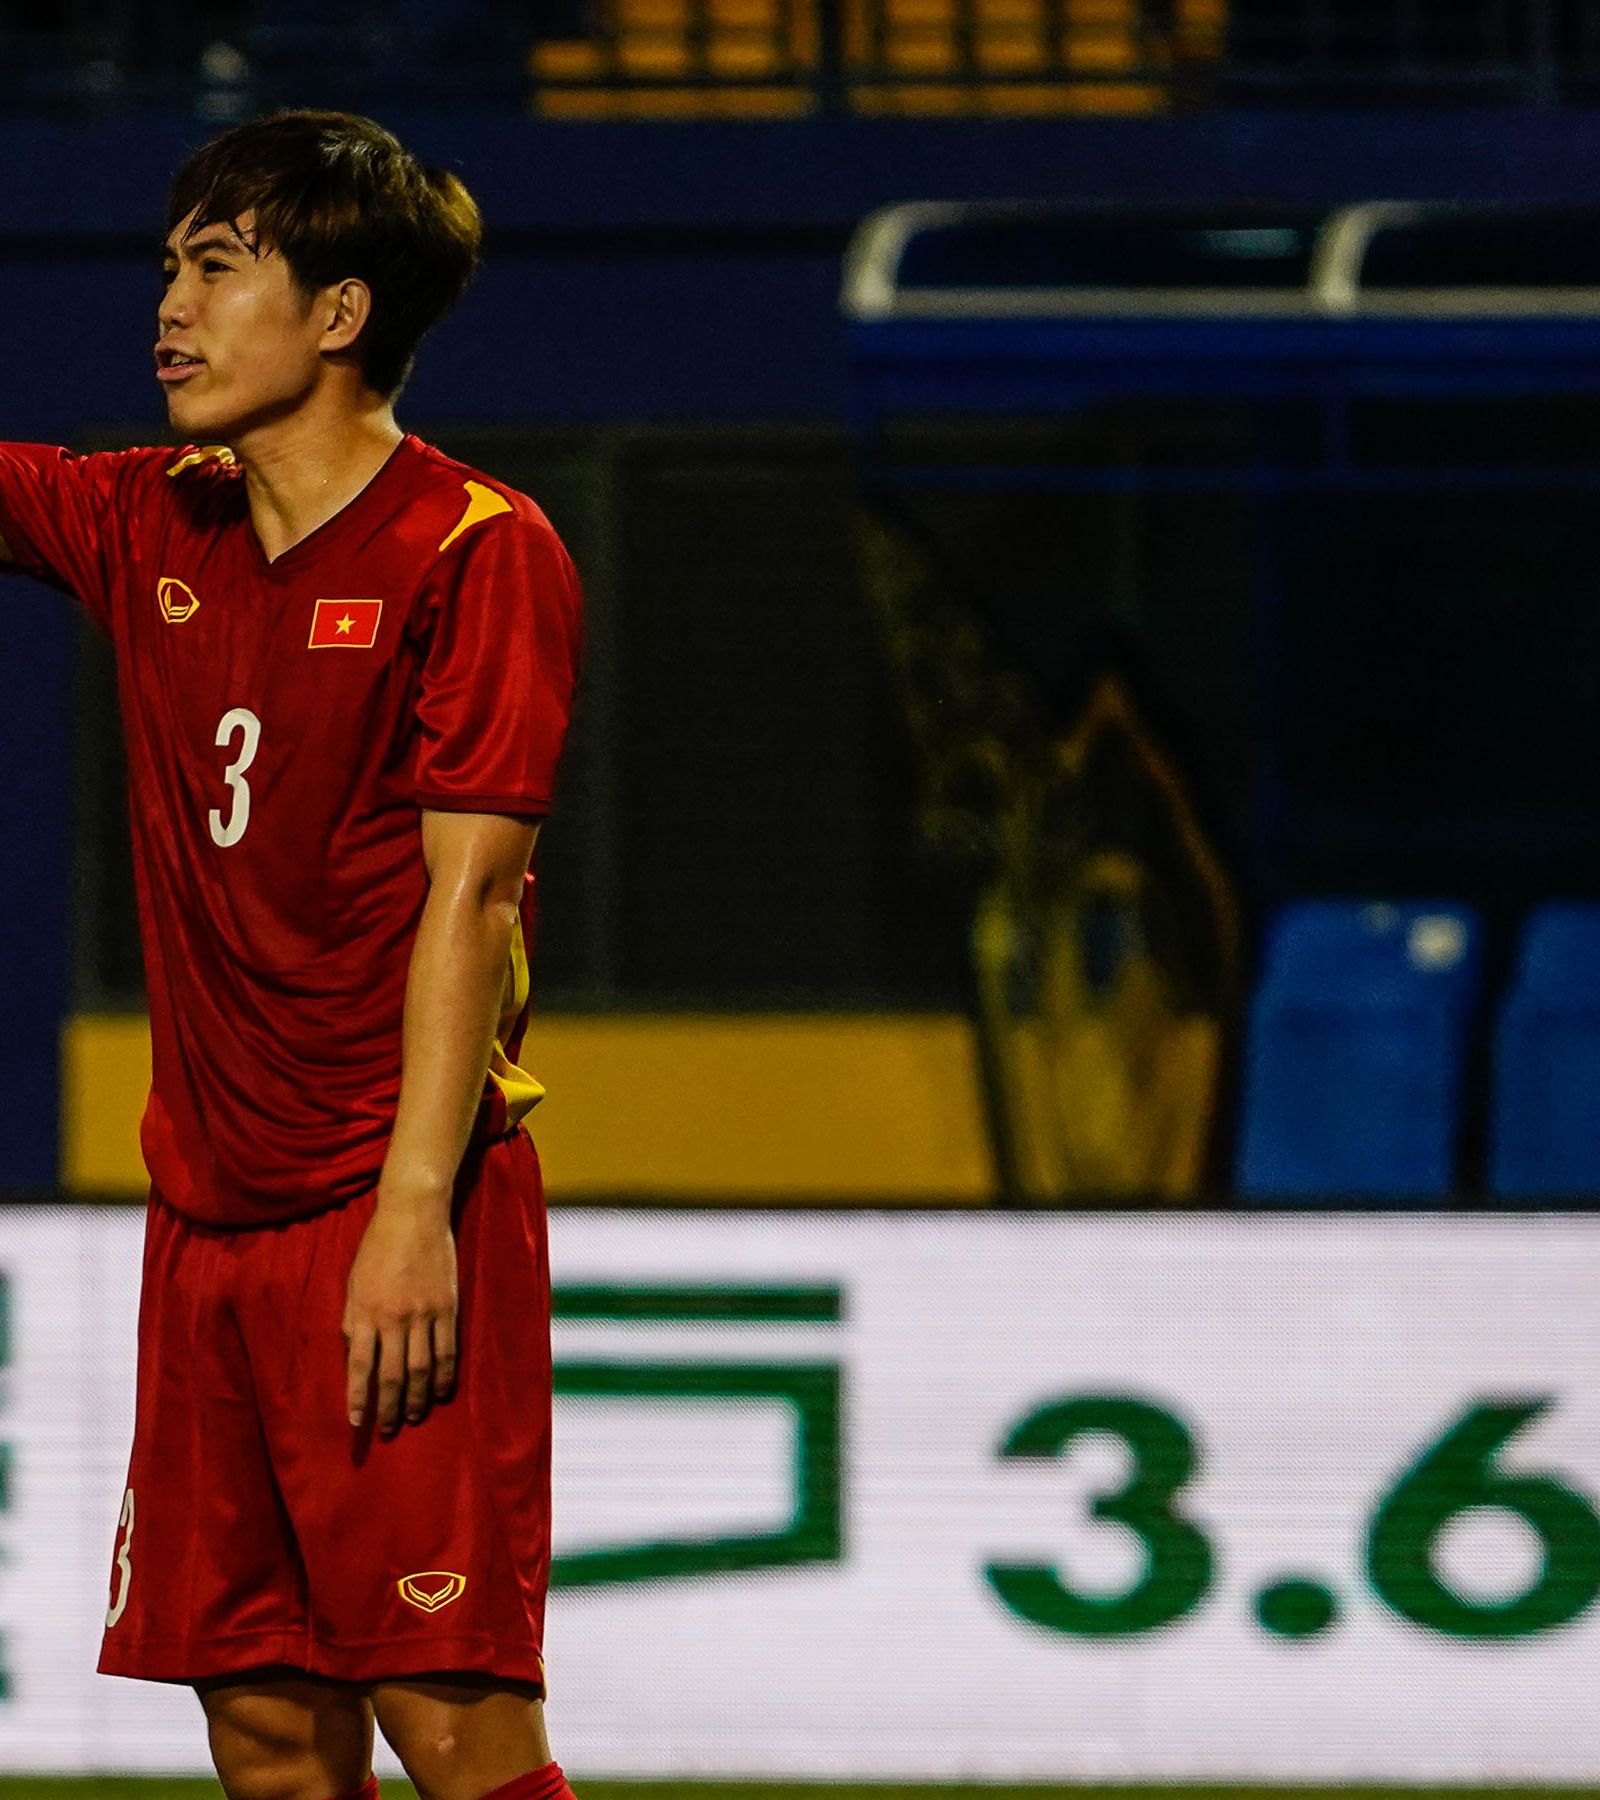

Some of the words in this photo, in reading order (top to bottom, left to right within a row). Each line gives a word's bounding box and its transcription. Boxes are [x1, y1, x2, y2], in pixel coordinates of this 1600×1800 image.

[209, 707, 261, 848] 3
[106, 1488, 135, 1628] 3
[980, 1390, 1600, 1643] 3.6
